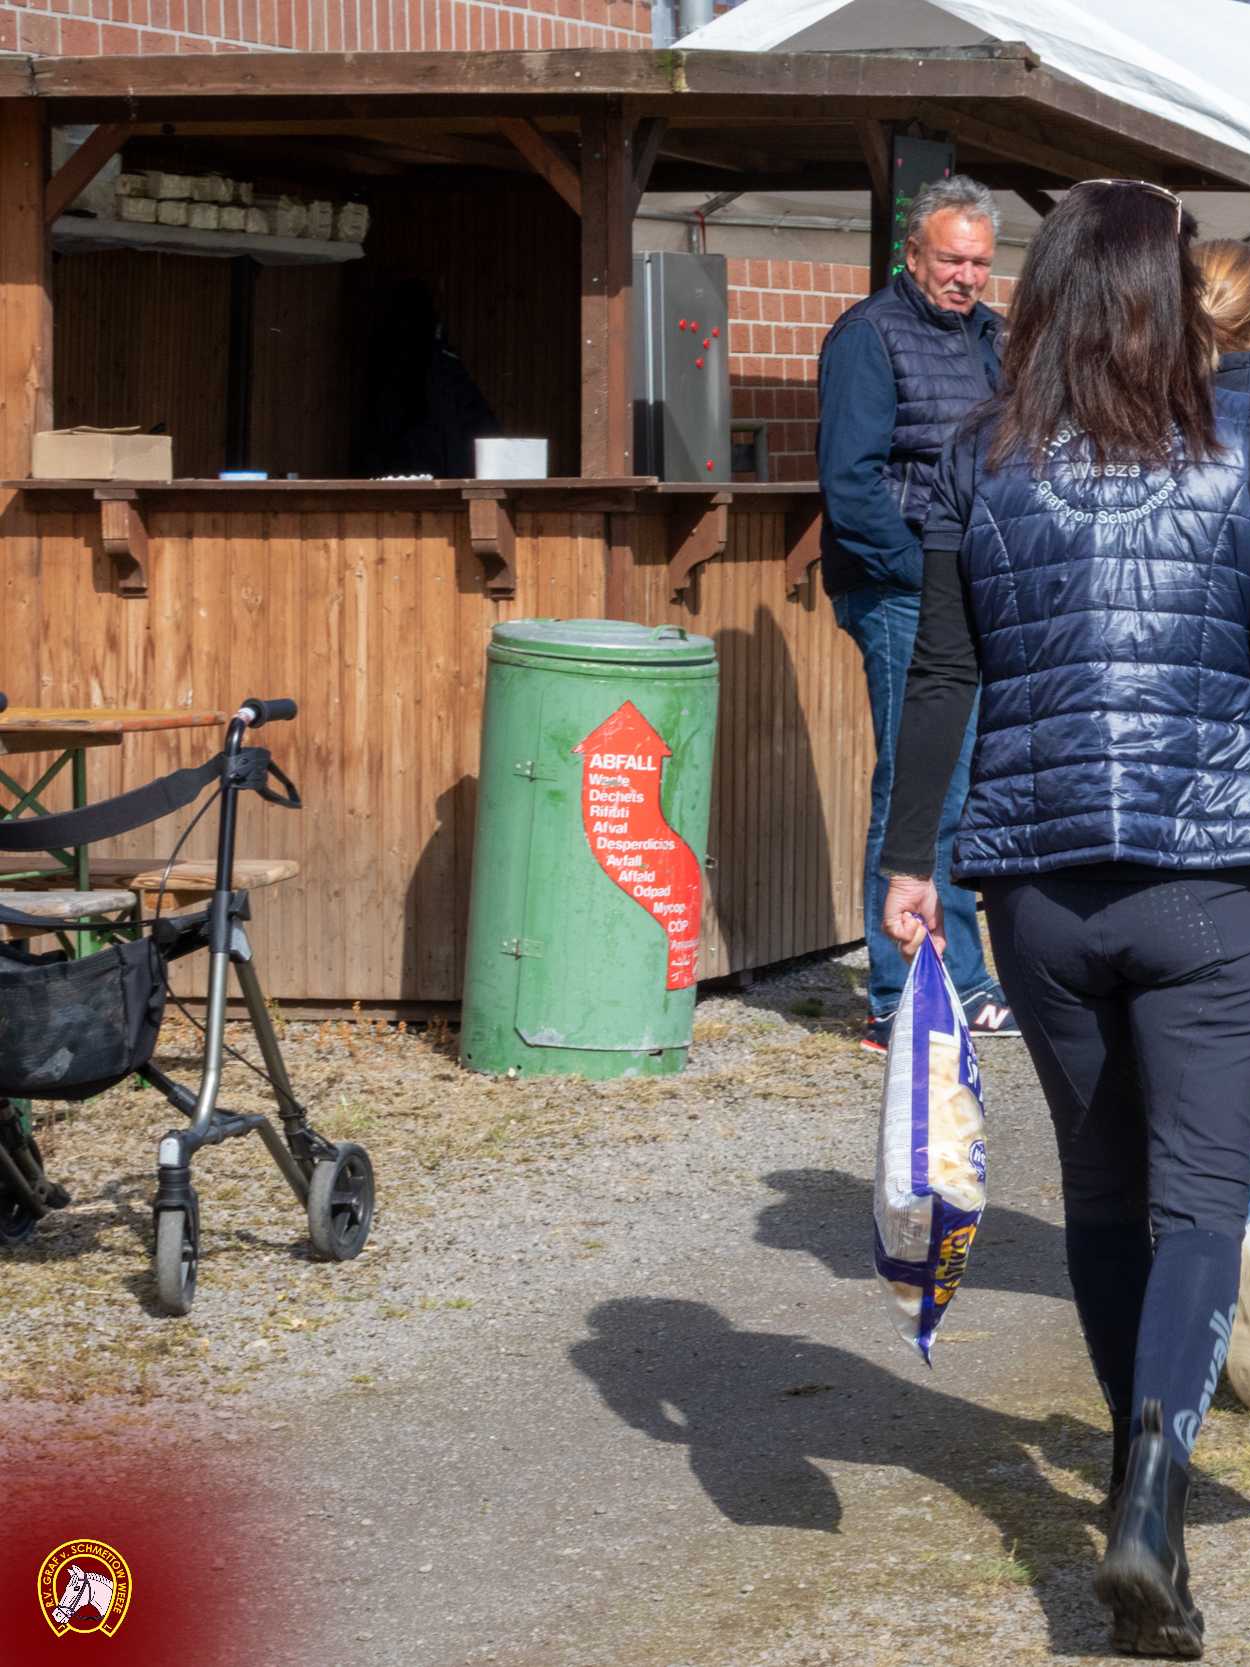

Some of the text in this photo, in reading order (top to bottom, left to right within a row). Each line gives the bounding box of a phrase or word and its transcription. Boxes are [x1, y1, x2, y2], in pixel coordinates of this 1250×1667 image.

[1071, 462, 1141, 479] Weeze
[1038, 477, 1177, 524] Graf von Schmettow
[589, 753, 657, 771] ABFALL
[593, 821, 628, 834] Afval
[606, 854, 642, 868] Avfall
[618, 870, 656, 883] Affald
[633, 885, 671, 900] Odpad
